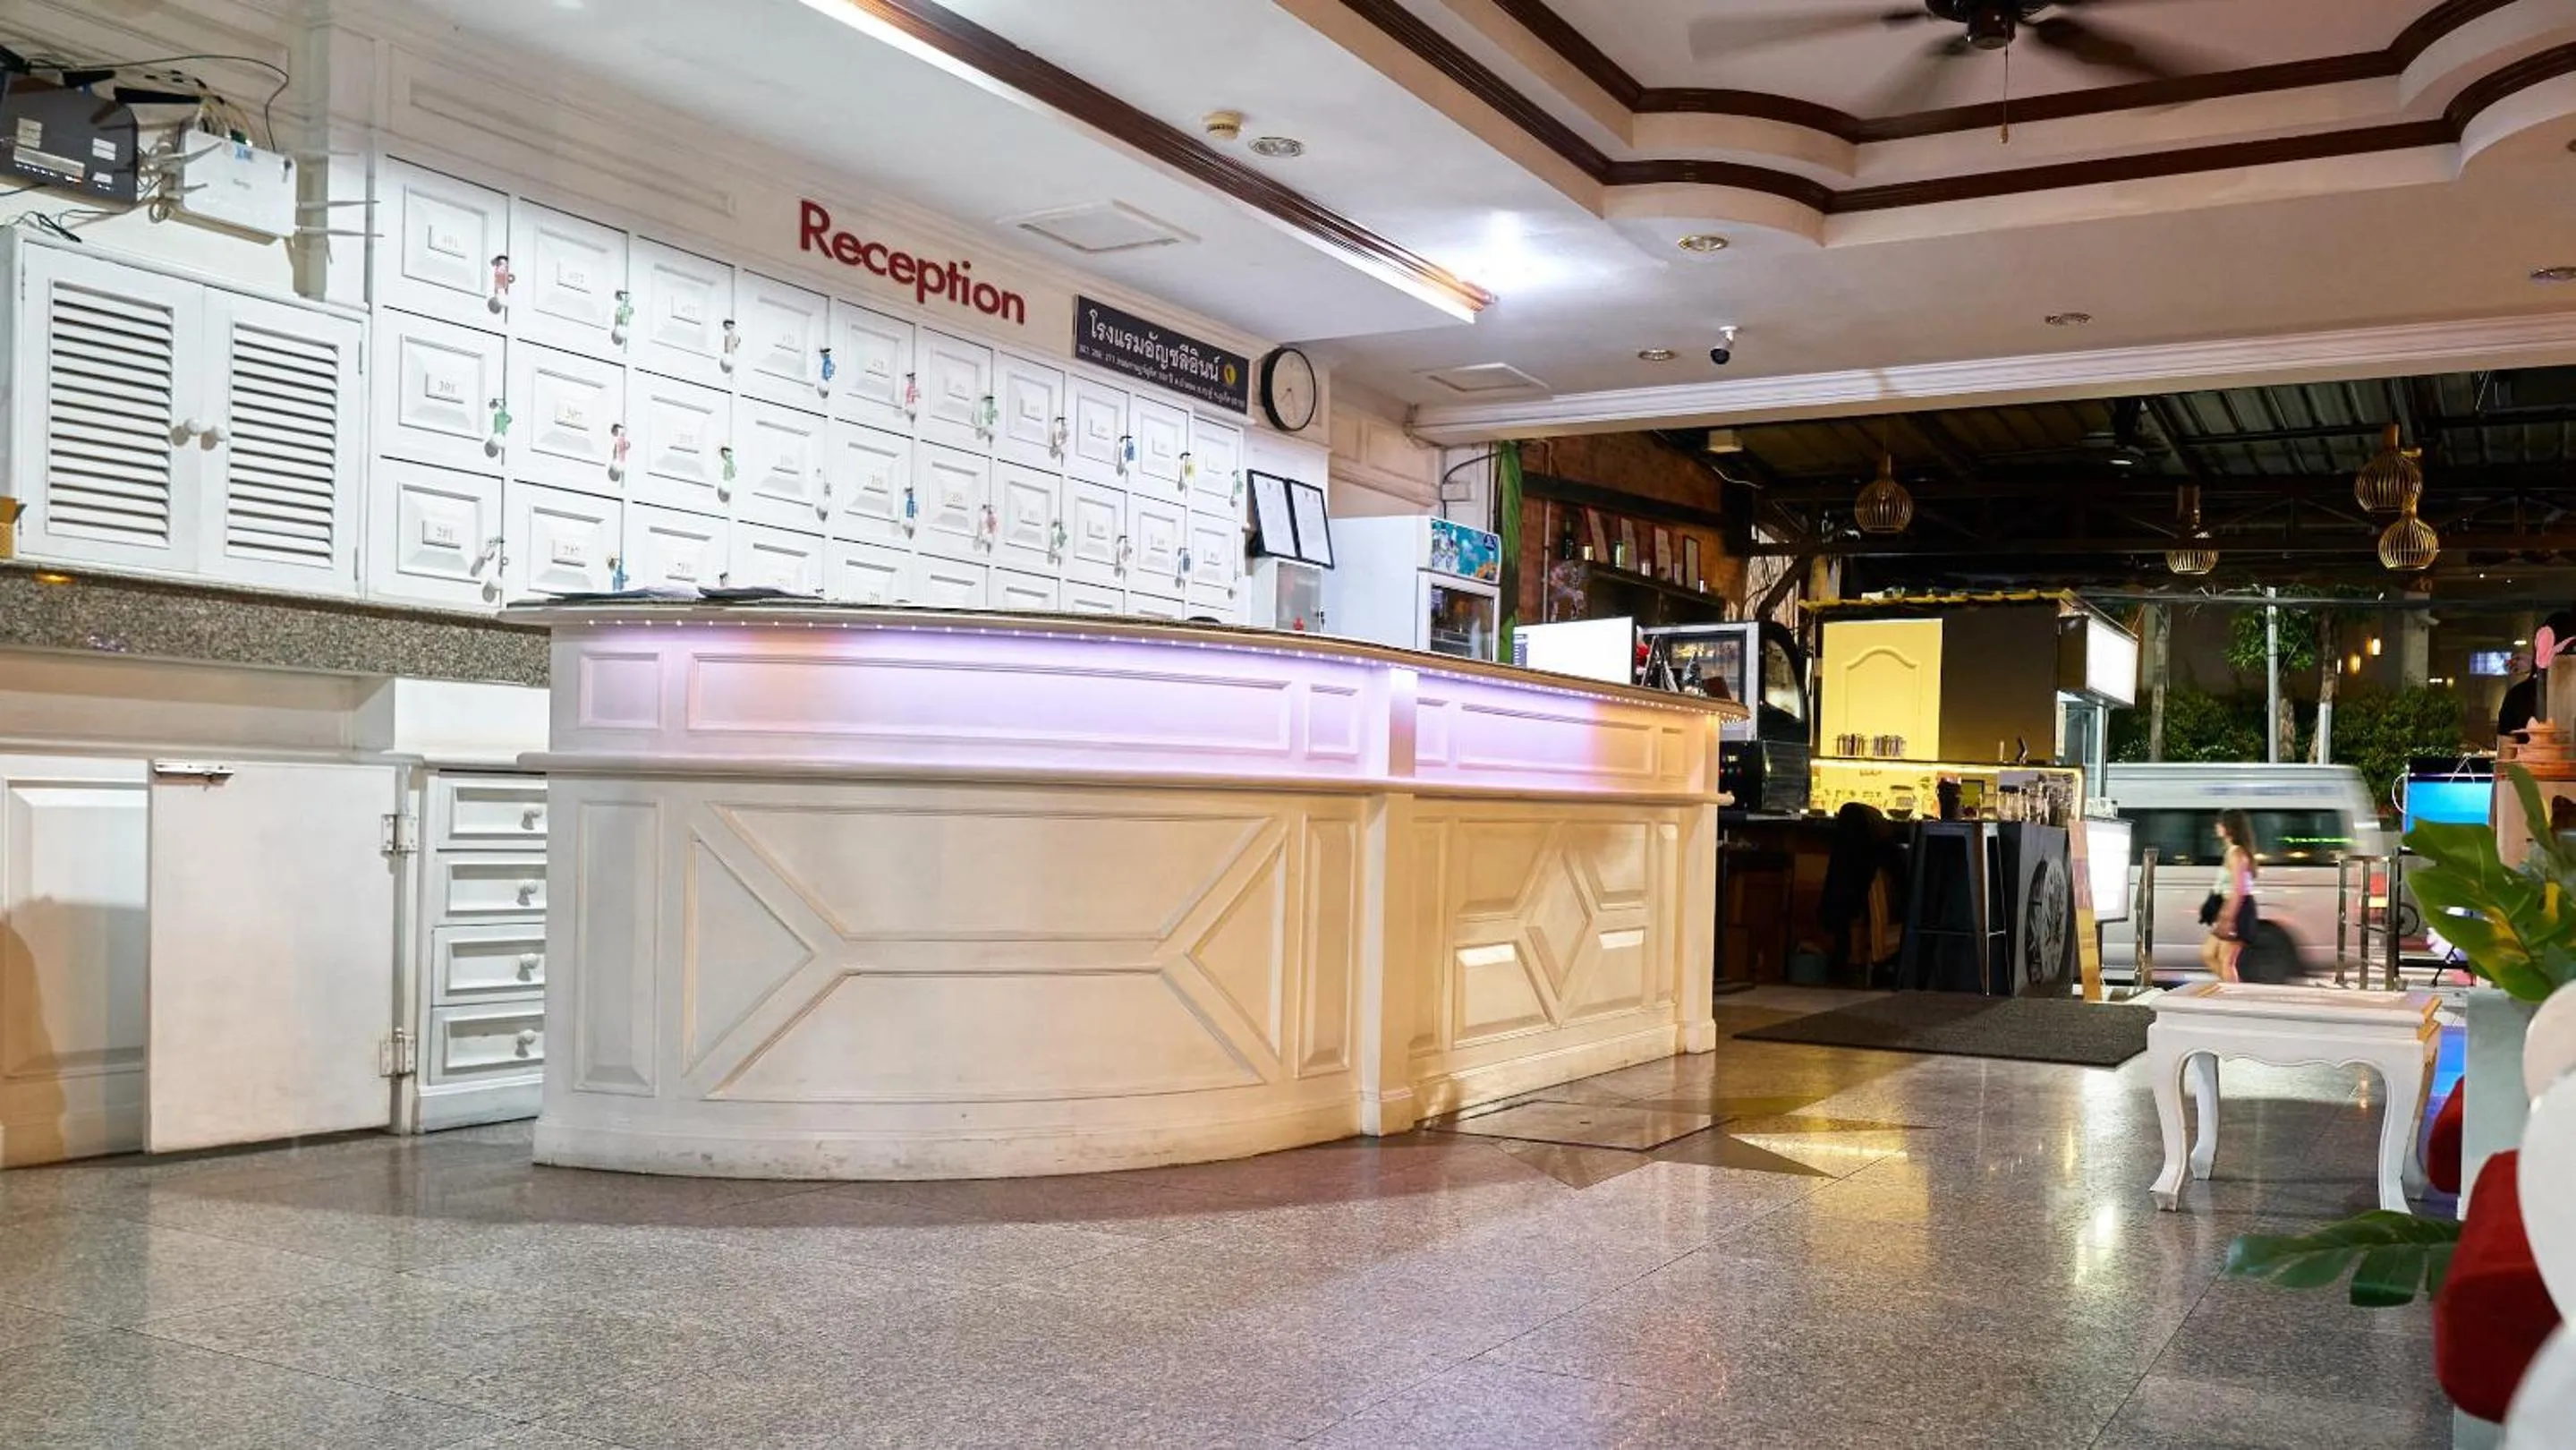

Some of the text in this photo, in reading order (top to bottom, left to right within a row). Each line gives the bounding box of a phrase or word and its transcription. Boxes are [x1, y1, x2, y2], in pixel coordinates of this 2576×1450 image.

[800, 200, 1024, 325] Reception
[1089, 308, 1220, 382] โรงแรมอัญชลีอินน์
